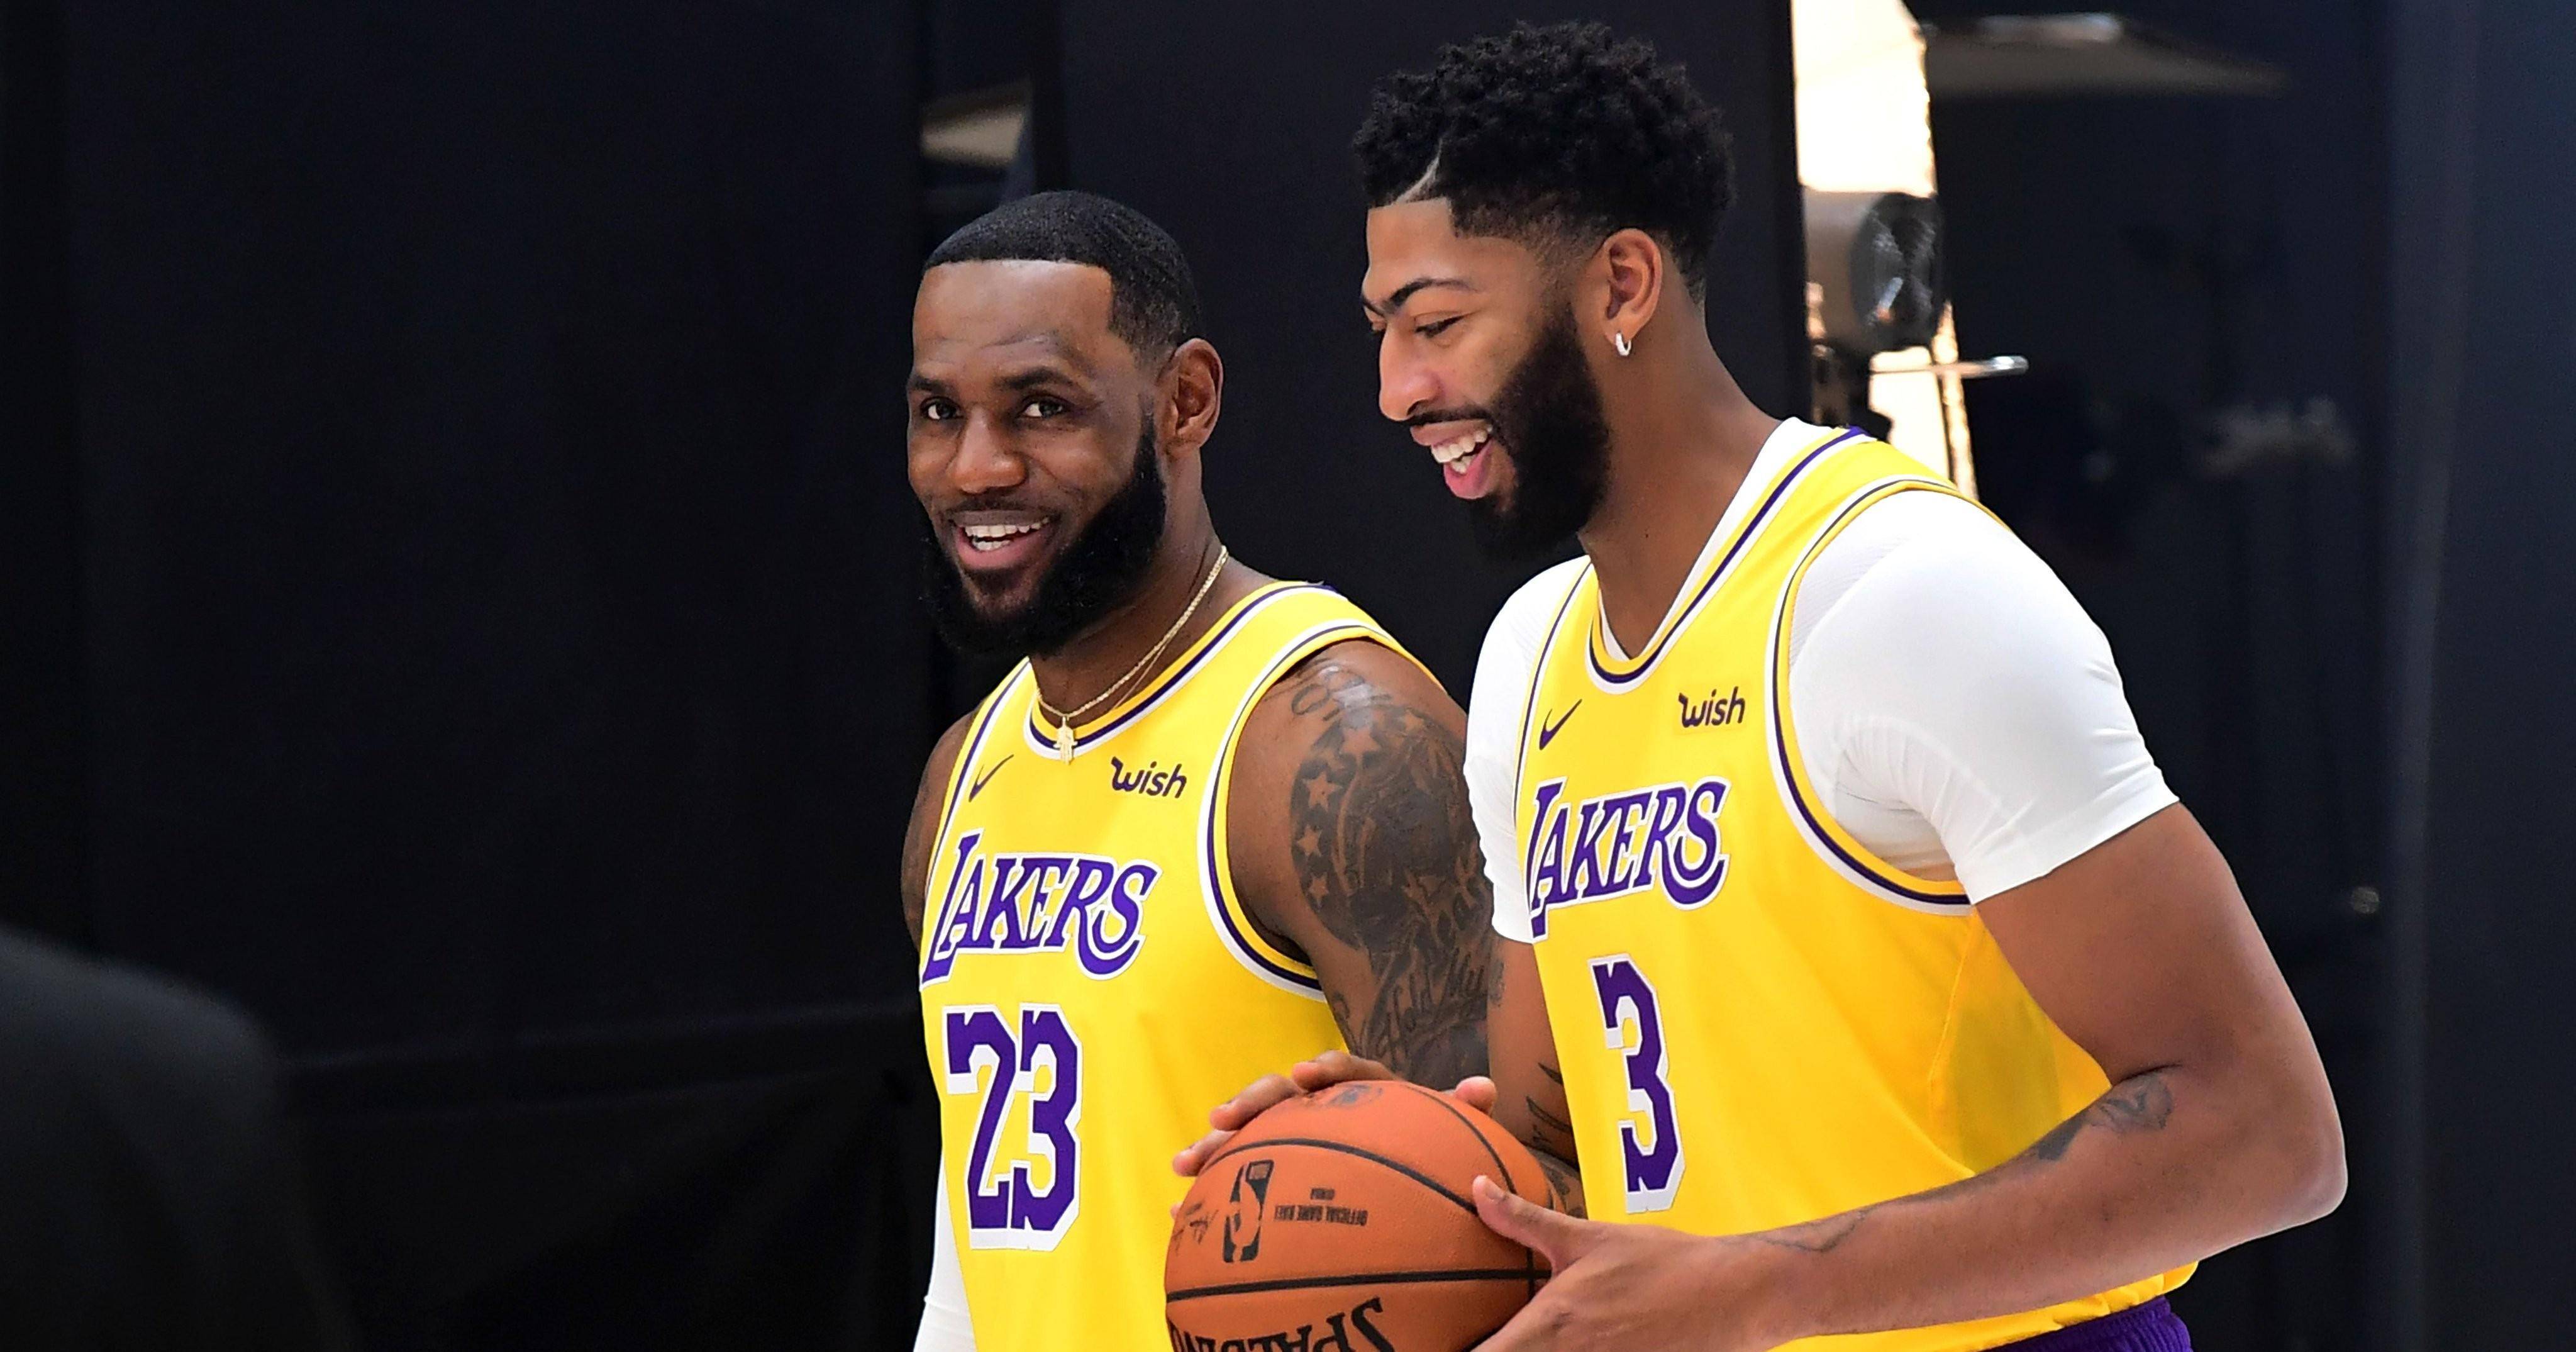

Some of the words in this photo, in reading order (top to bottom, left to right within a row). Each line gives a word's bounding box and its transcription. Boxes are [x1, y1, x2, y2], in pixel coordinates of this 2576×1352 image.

[1111, 756, 1187, 799] wish
[1678, 686, 1746, 729] wish
[920, 827, 1163, 991] LAKERS
[1524, 776, 1731, 943] LAKERS
[941, 1003, 1083, 1251] 23
[1588, 953, 1686, 1214] 3
